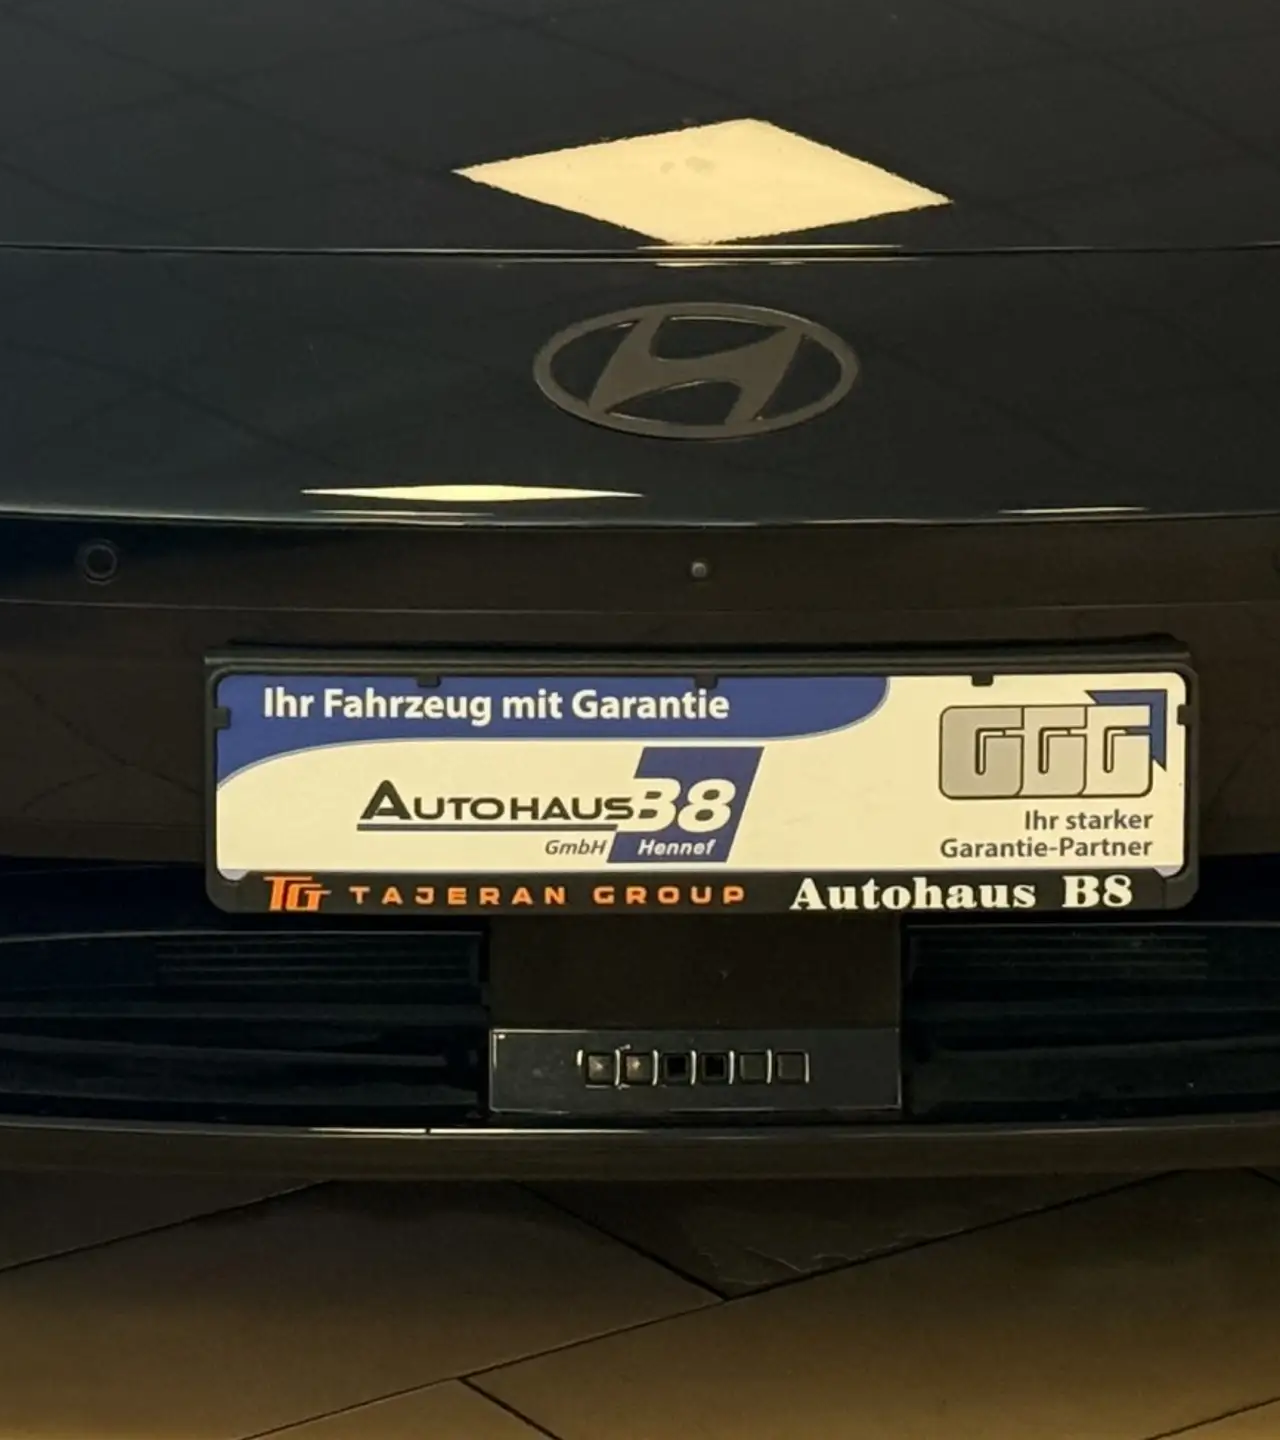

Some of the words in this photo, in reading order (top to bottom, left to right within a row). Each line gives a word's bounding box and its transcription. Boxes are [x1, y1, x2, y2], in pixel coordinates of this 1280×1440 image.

[264, 687, 315, 718] Ihr
[324, 688, 492, 727] Fahrzeug
[502, 689, 563, 719] mit
[572, 689, 730, 720] Garantie
[360, 779, 634, 821] AUTOHAUS
[623, 776, 736, 833] B8
[1025, 810, 1059, 830] Ihr
[1066, 809, 1154, 830] starker
[544, 839, 607, 857] GmbH
[637, 838, 718, 857] Hennef
[940, 837, 1153, 858] Garantie-Partner
[349, 885, 566, 905] TAJERAN
[593, 885, 746, 905] GROUP
[788, 876, 1036, 910] Autohaus
[1061, 874, 1133, 908] B8
